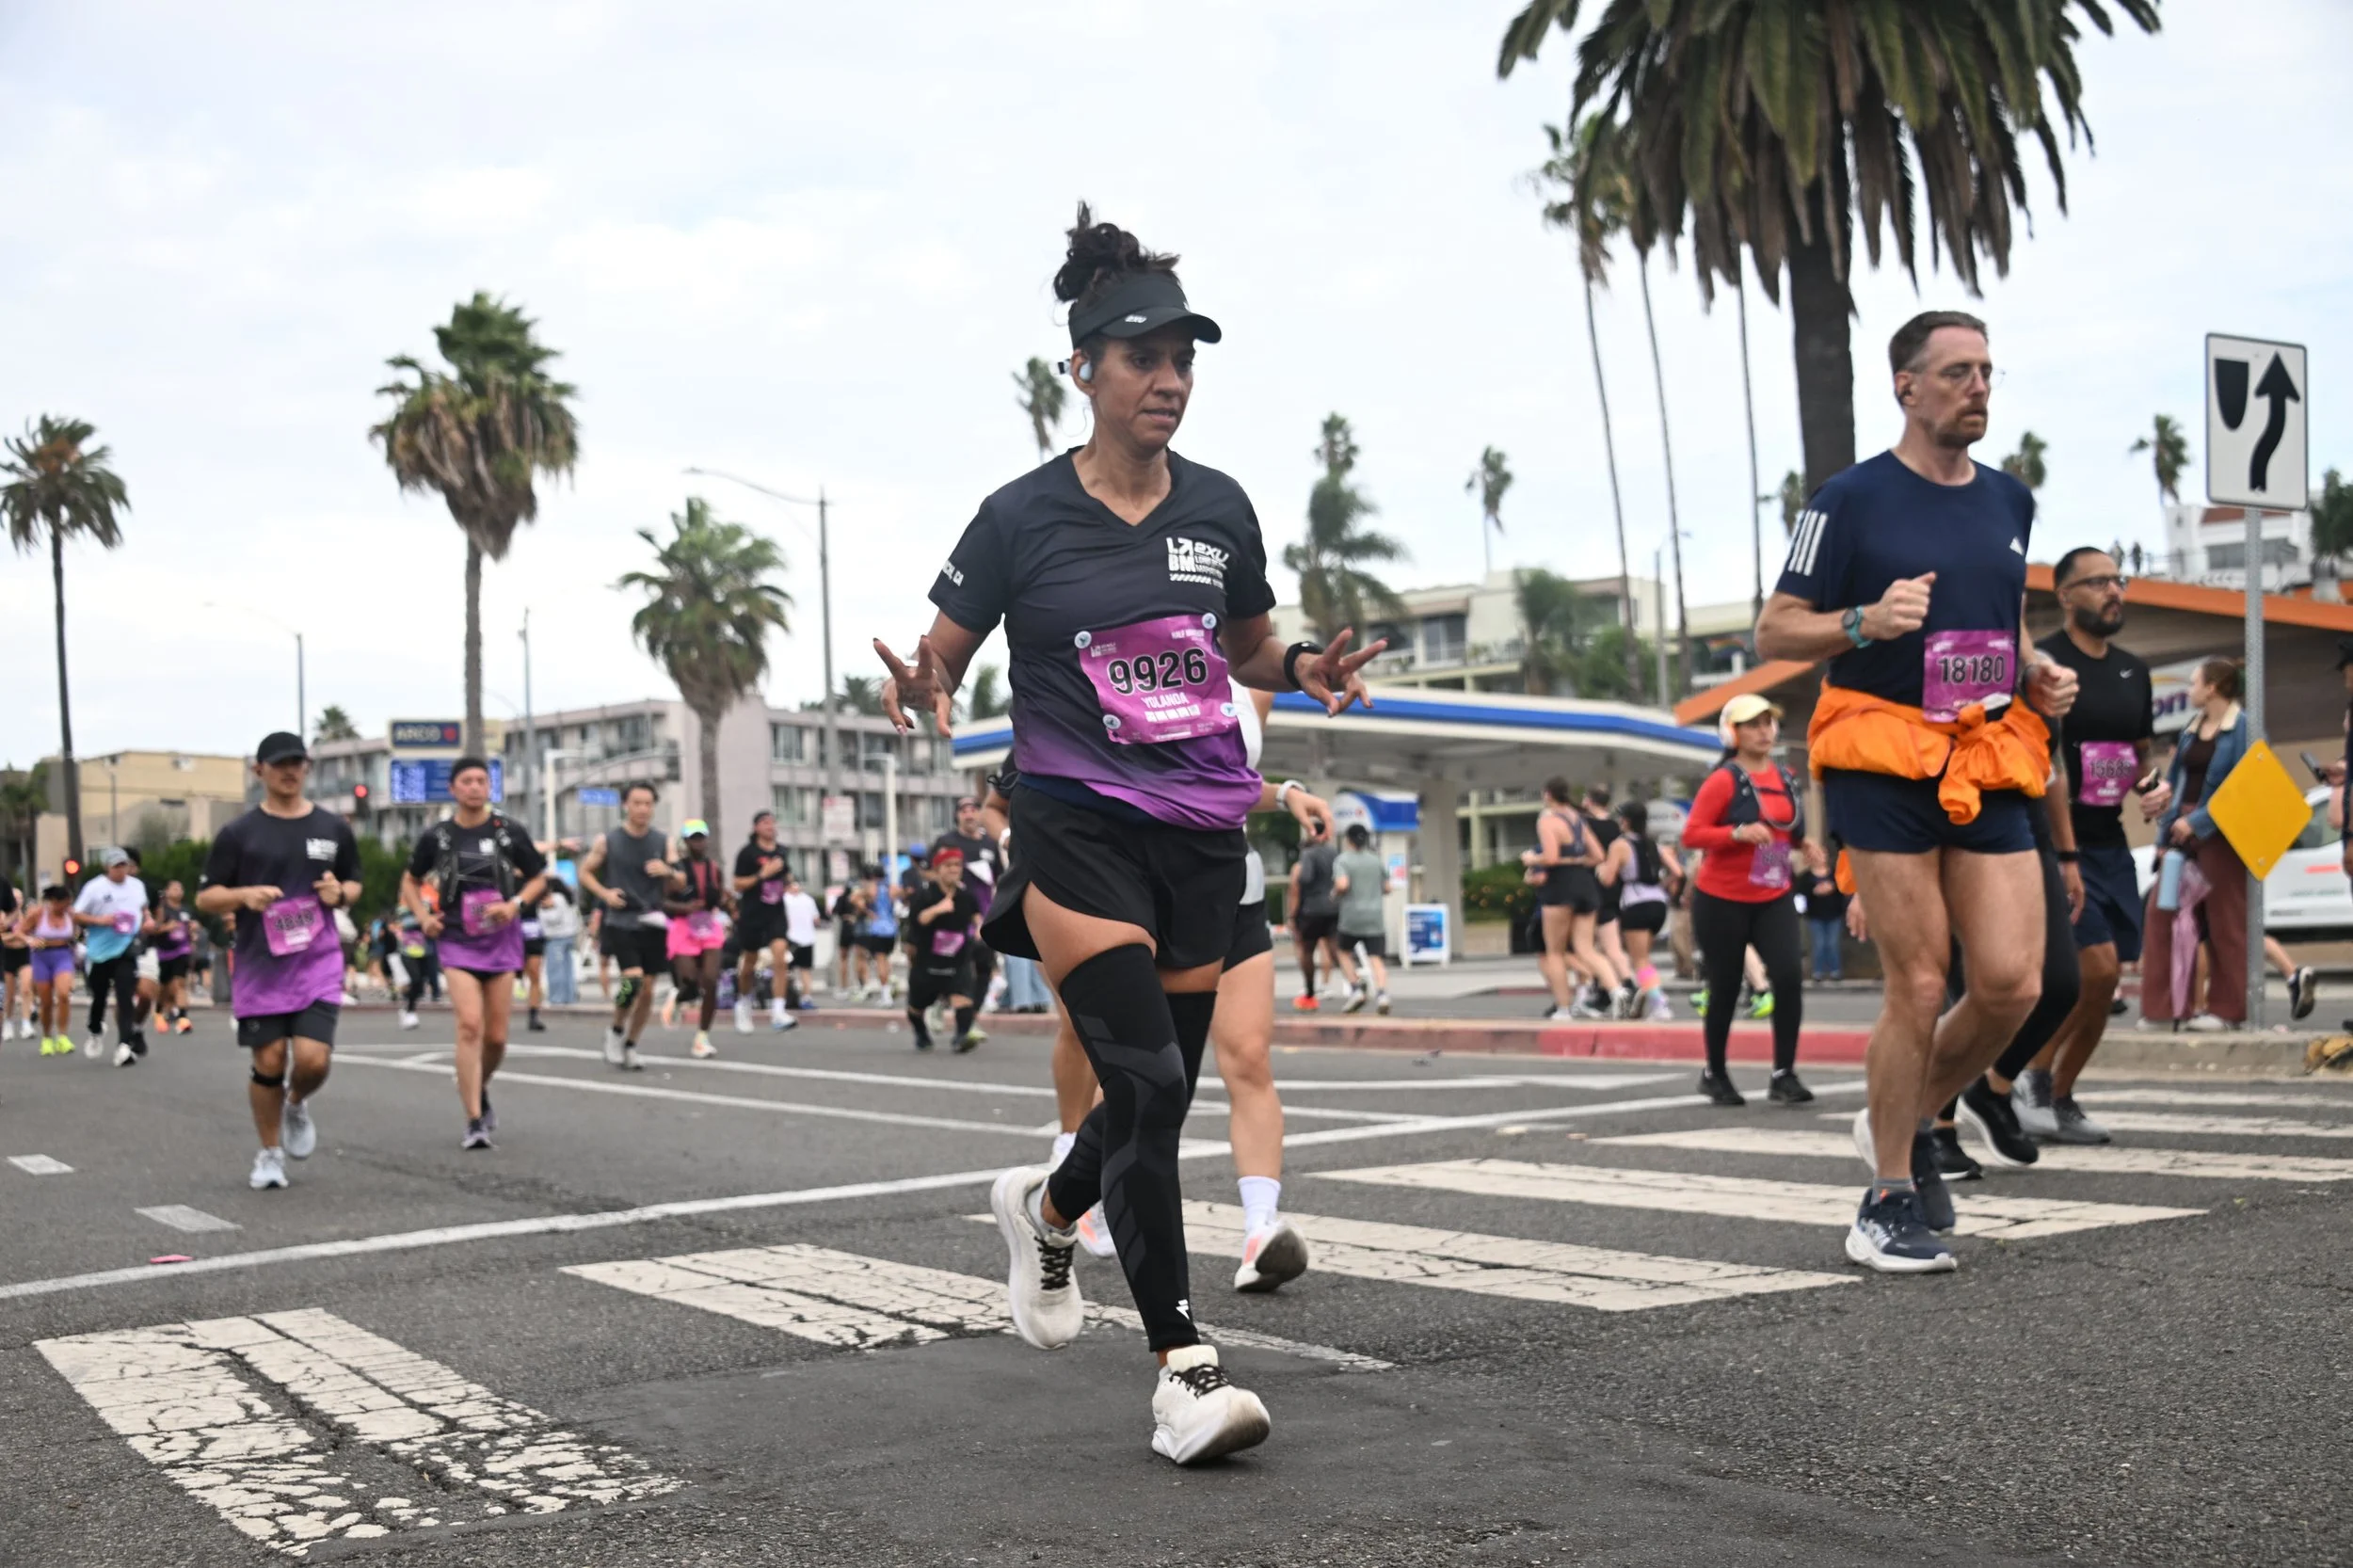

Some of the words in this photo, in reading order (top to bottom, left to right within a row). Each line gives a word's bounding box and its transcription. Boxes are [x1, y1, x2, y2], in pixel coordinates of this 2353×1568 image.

[1194, 541, 1229, 563] 2XU
[1108, 648, 1209, 696] 9926
[1938, 656, 2005, 684] 18180
[1141, 692, 1190, 709] YOLANDA
